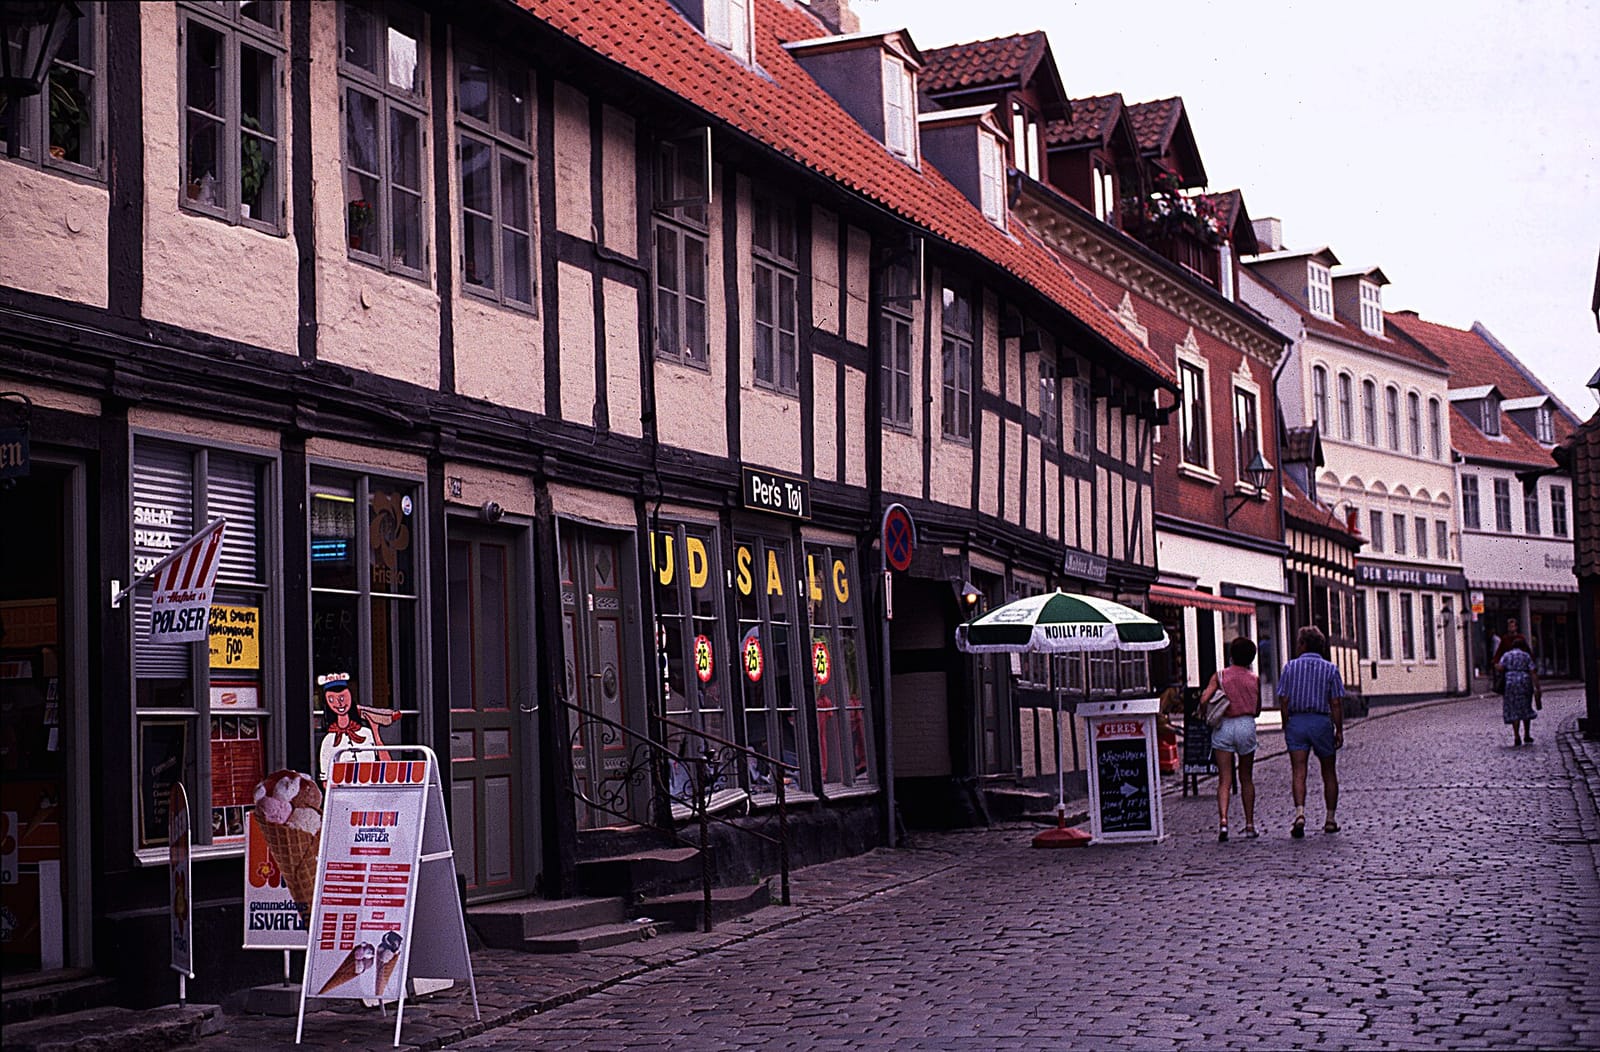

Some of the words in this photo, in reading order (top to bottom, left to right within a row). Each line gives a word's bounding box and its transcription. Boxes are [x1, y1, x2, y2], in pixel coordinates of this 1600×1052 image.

[752, 475, 782, 508] Per's
[784, 482, 803, 517] Tøj
[134, 507, 173, 525] SALAT
[134, 529, 172, 549] PIZZA
[151, 607, 206, 635] PØLSER
[1044, 625, 1077, 639] NOILLY
[1079, 625, 1104, 638] PRAT
[1103, 723, 1137, 734] CERES
